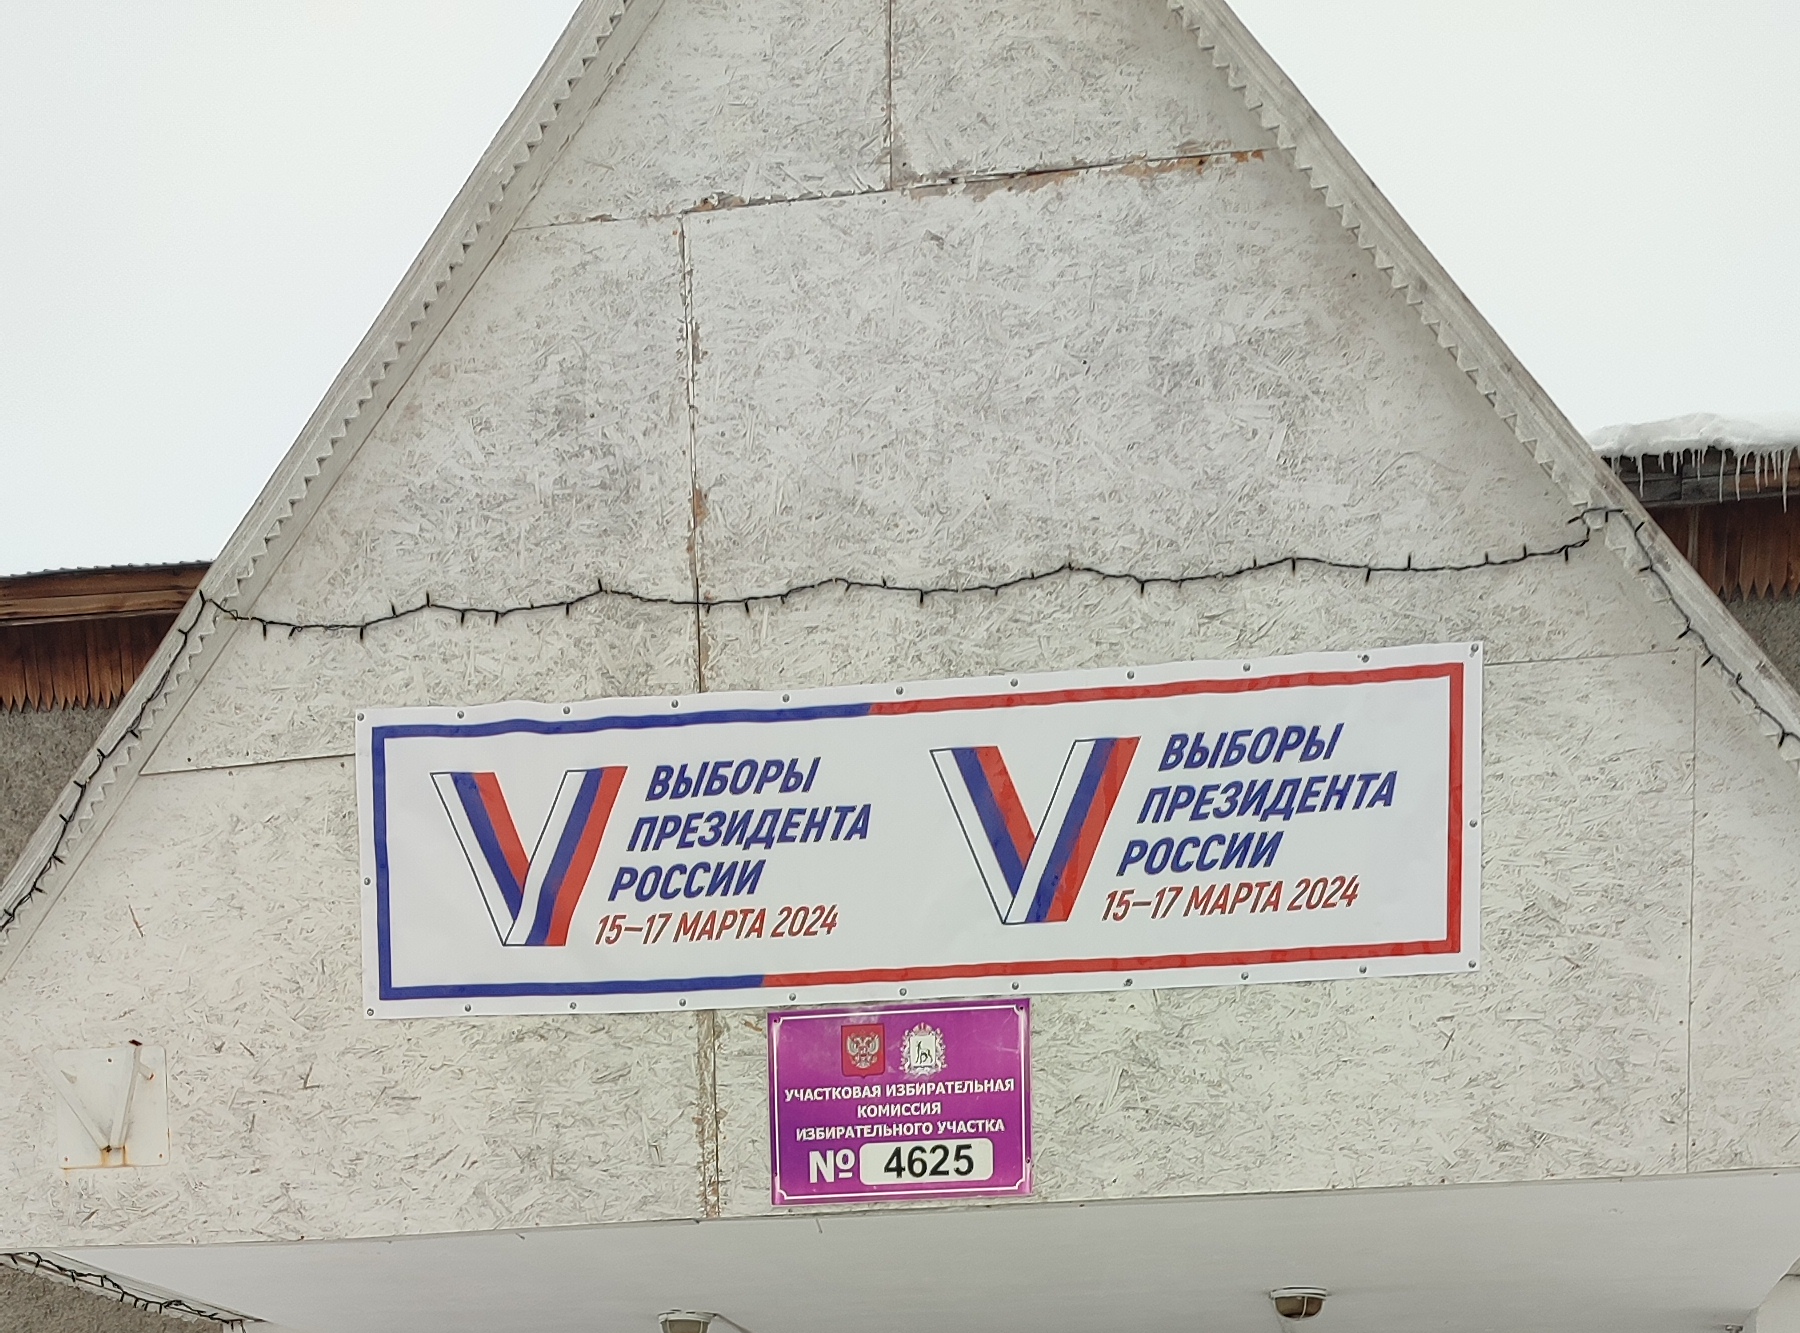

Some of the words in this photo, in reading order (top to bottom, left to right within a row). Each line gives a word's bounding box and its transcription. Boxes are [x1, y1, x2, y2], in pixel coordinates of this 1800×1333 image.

[1158, 722, 1345, 772] ВЫБОРЫ
[646, 757, 820, 802] ВЫБОРЫ
[1137, 771, 1397, 824] ПРЕЗИДЕНТА
[626, 804, 871, 852] ПРЕЗИДЕНТА
[1116, 831, 1284, 876] РОССИИ
[608, 860, 766, 902] РОССИИ
[1184, 881, 1282, 919] МАРТА
[1287, 875, 1360, 913] 2024
[673, 907, 765, 943] МАРТА
[770, 904, 838, 938] 2024
[785, 1085, 881, 1102] УЧАСТКОВАЯ
[886, 1078, 1014, 1097] ИЗБИРАТЕЛЬНАЯ
[857, 1102, 942, 1119] КОМИССИЯ
[796, 1122, 933, 1141] ИЗБИРАТЕЛЬНОГО
[937, 1119, 1005, 1135] УЧАСТКА
[884, 1144, 974, 1179] 4625
